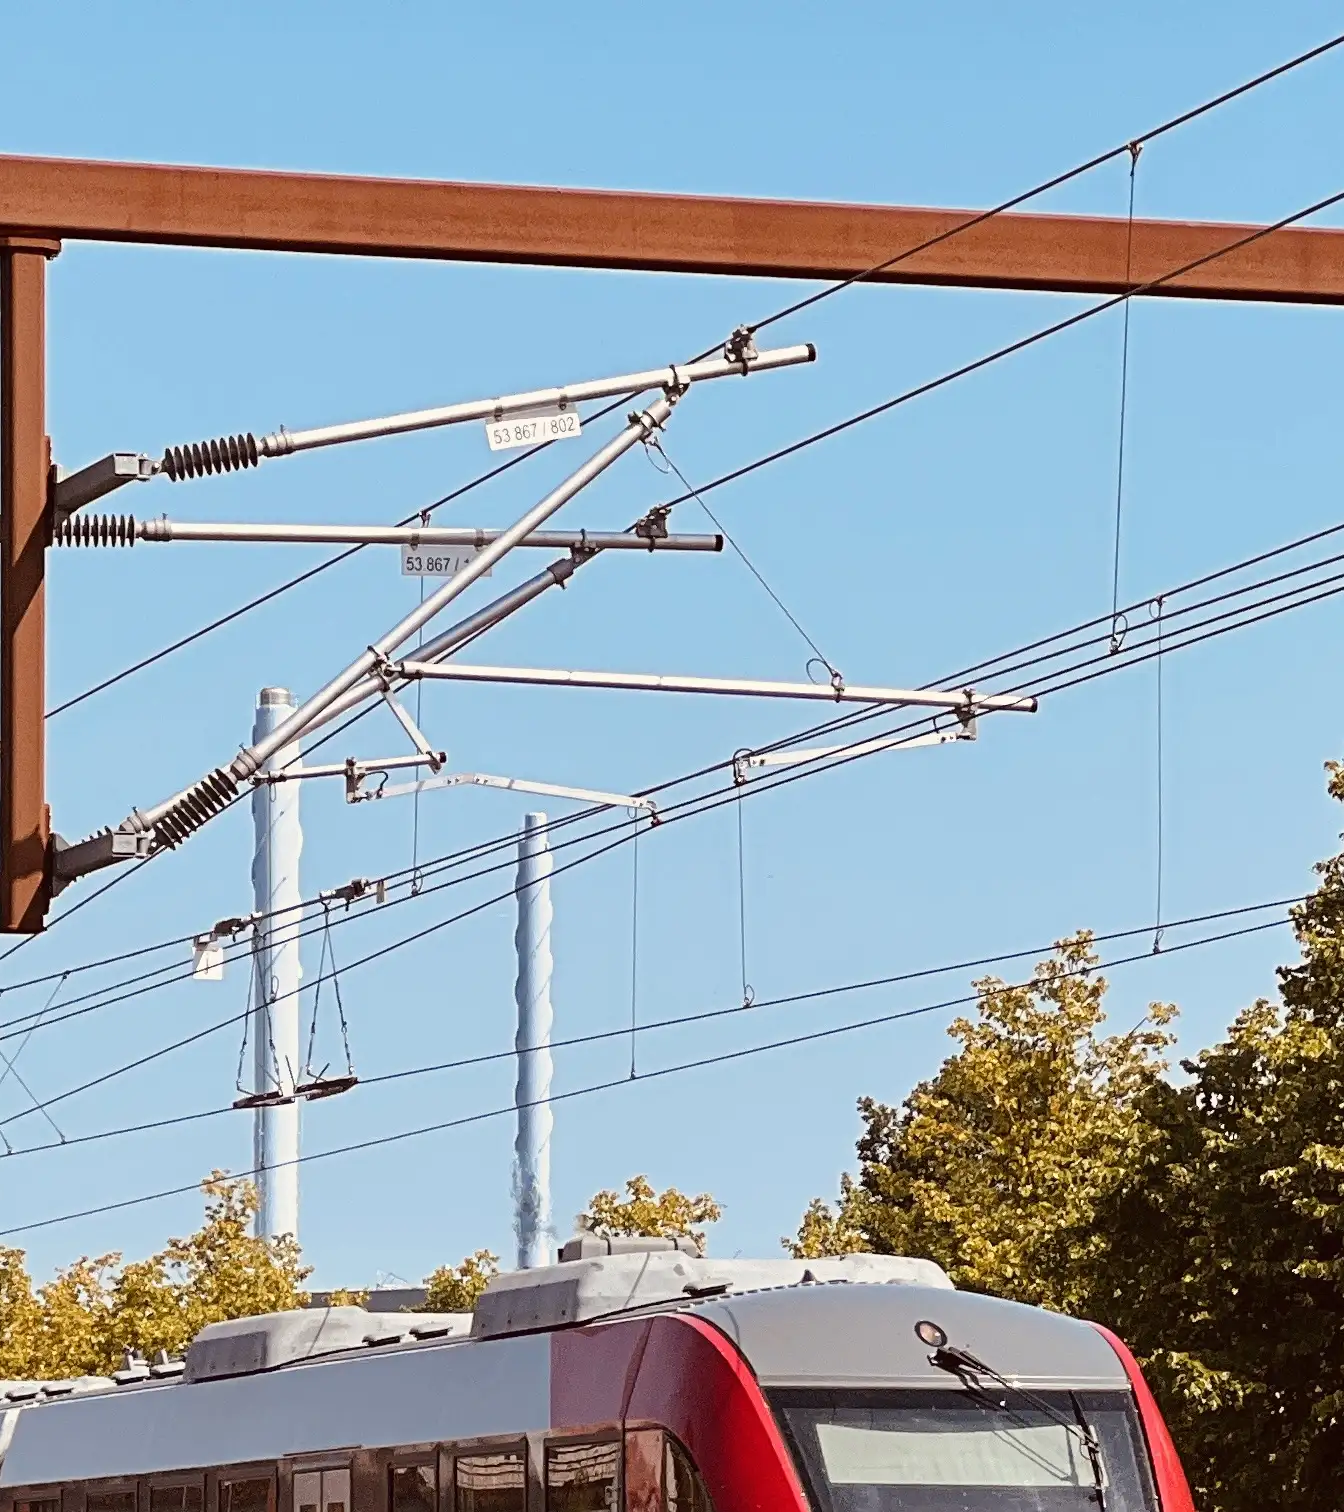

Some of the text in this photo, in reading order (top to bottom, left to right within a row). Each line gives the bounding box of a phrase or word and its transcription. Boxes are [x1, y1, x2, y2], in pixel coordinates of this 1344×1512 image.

[493, 428, 511, 444] 53
[514, 423, 537, 440] 867
[550, 416, 575, 434] 802
